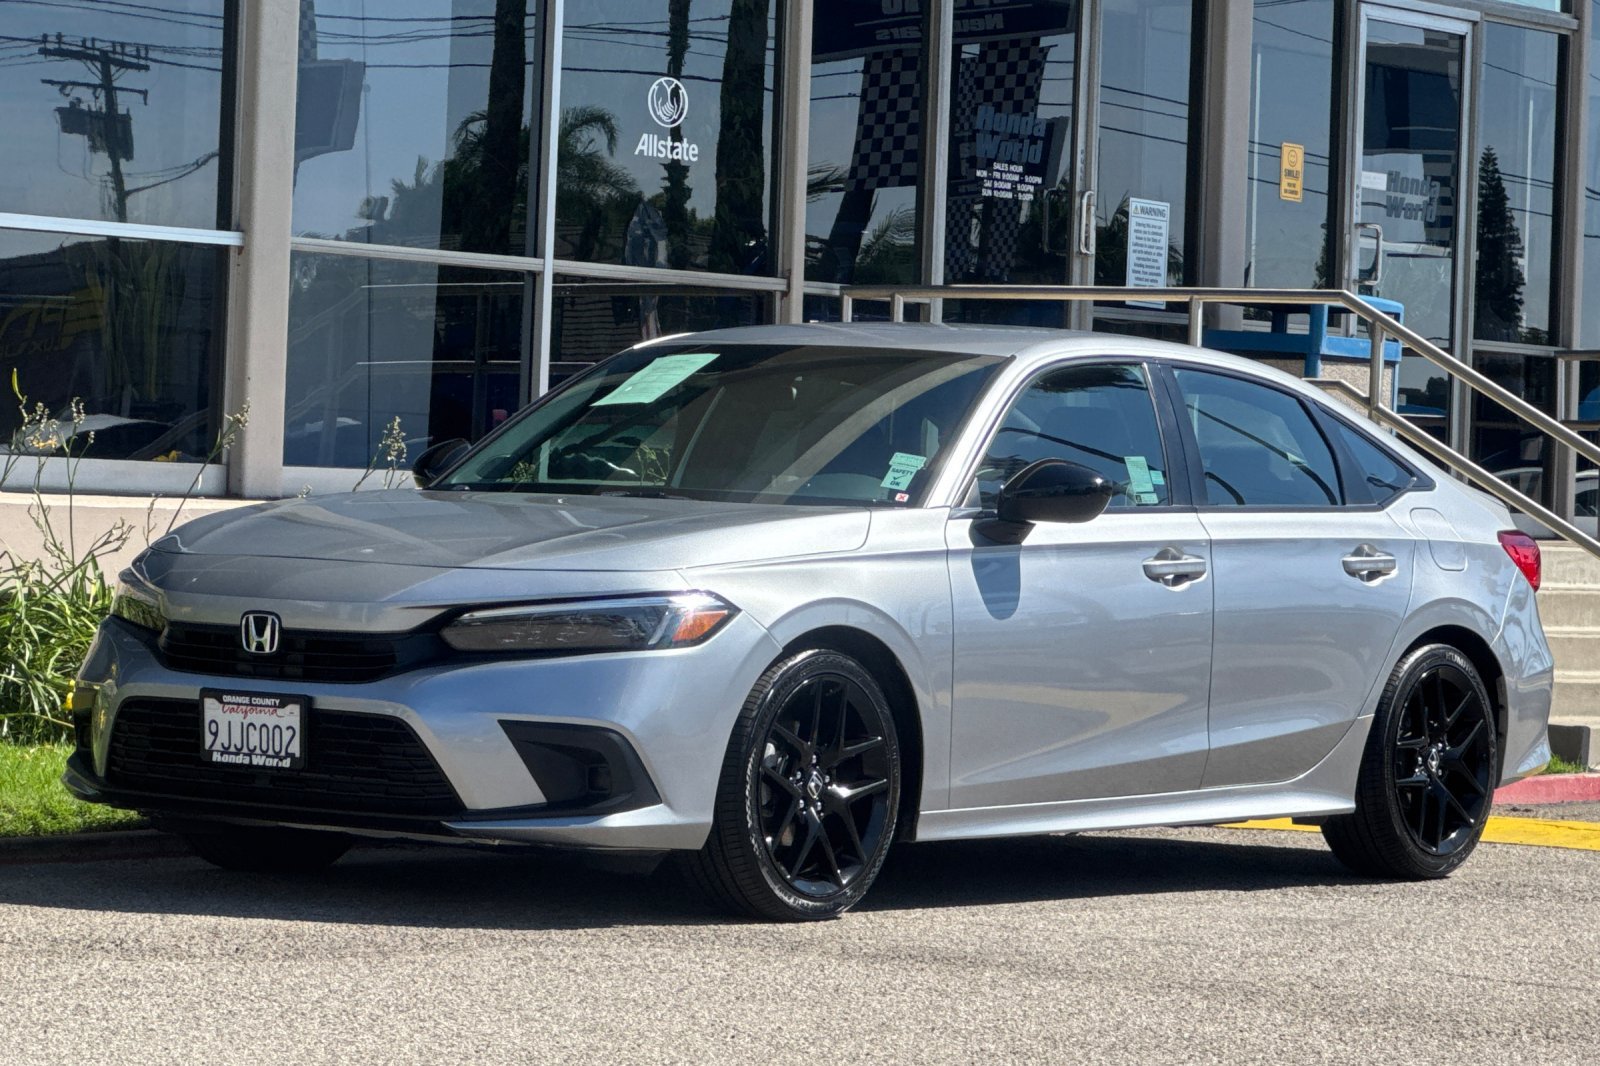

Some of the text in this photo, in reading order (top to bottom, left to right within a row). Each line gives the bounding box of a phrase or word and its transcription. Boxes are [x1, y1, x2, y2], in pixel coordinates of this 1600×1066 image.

[976, 105, 1046, 137] Honda
[634, 133, 699, 161] Allstate
[976, 133, 1043, 164] World
[993, 162, 1009, 171] SALES
[976, 169, 988, 178] MON
[992, 171, 1001, 180] FRI
[1386, 170, 1440, 198] Honda
[981, 188, 993, 197] SUN
[1139, 205, 1166, 218] WARNING
[1386, 195, 1438, 223] World
[891, 467, 914, 475] SAFETY
[222, 694, 281, 706] ORANGE COUNTY
[221, 704, 284, 719] California
[208, 719, 296, 757] 9JJC002
[212, 751, 250, 764] Honda
